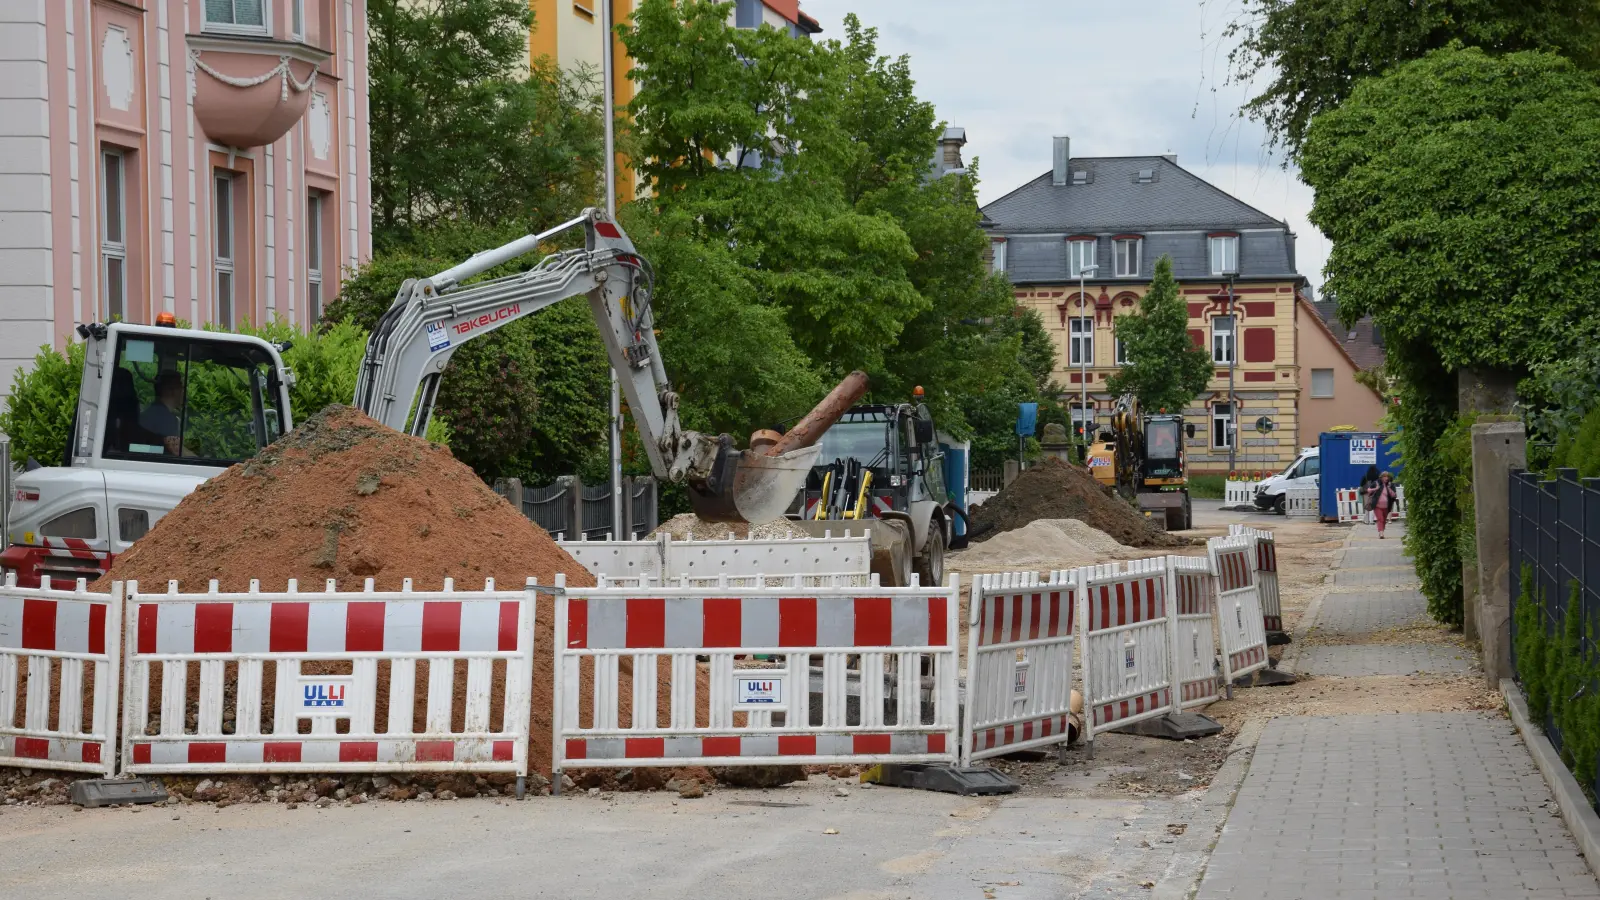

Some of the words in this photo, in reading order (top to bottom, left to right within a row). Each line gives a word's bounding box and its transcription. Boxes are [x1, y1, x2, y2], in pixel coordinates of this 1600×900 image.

[427, 320, 444, 333] ULLI
[1352, 440, 1374, 448] ULLI
[304, 684, 344, 700] ULLI
[748, 682, 772, 691] ULLI
